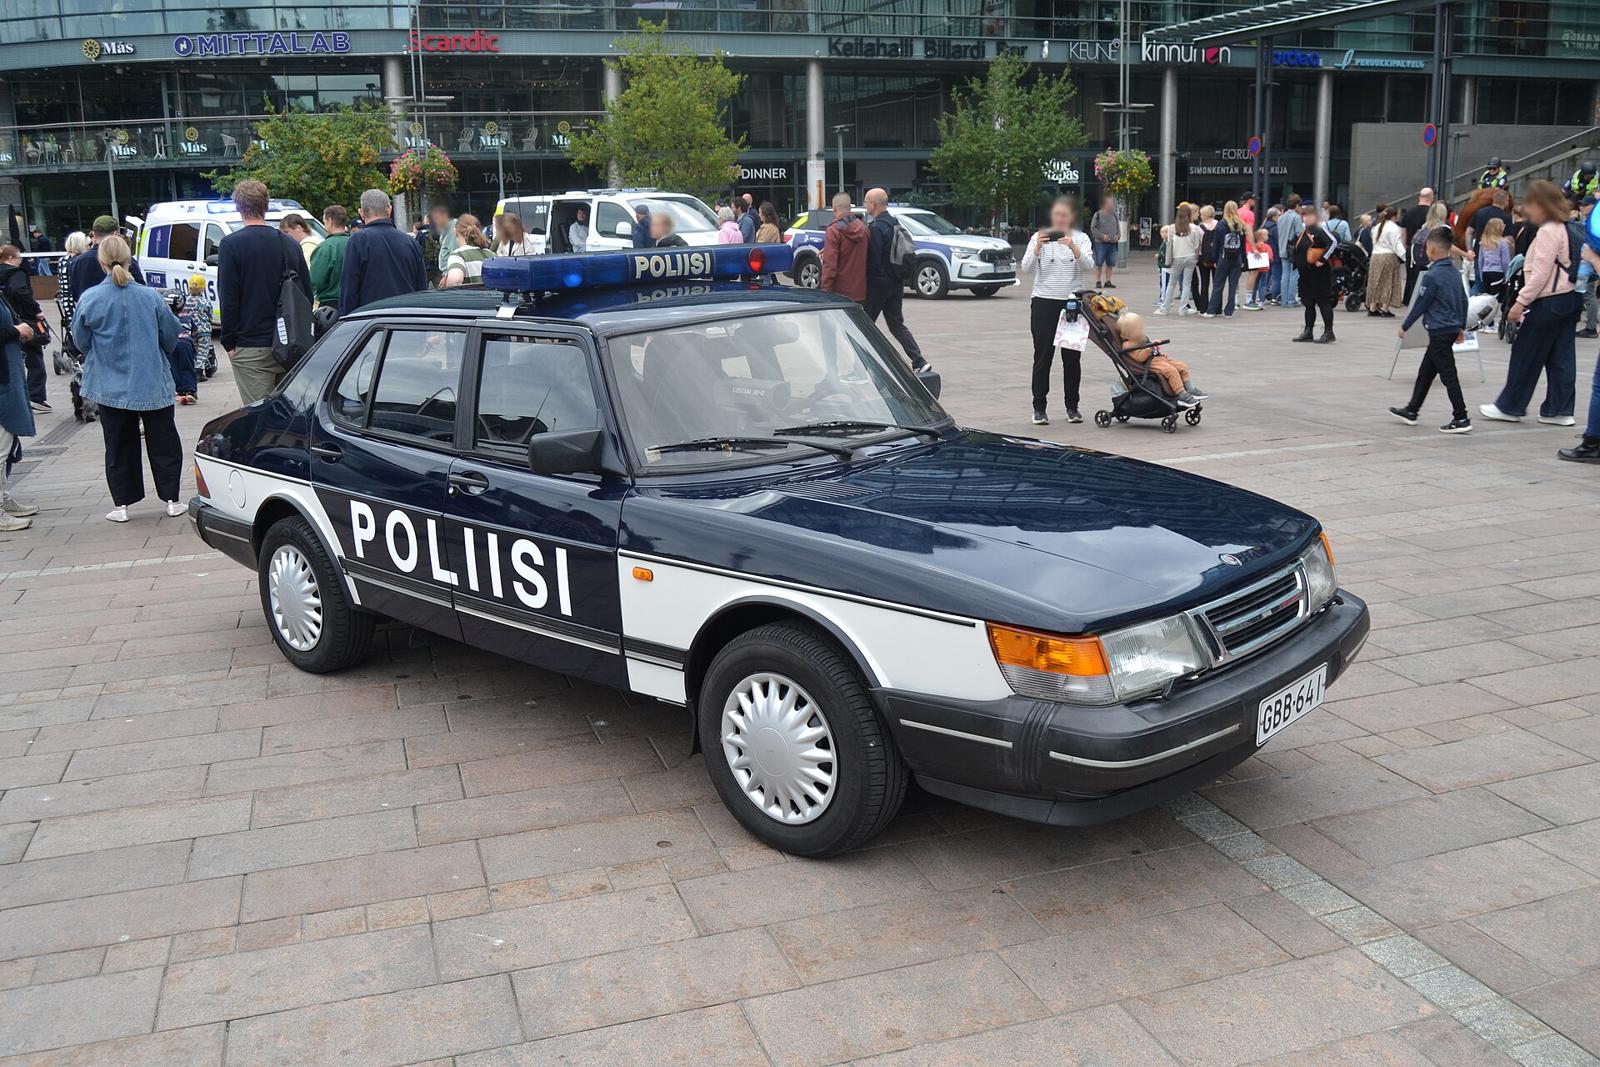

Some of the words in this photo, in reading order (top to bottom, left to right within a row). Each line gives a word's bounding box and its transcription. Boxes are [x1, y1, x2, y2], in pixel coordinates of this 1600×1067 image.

[102, 41, 134, 56] Más
[408, 30, 501, 52] Scandic
[827, 37, 913, 57] Keilahalli
[1069, 42, 1117, 61] KEUNE
[1264, 47, 1320, 66] ordea
[180, 142, 208, 154] Más
[480, 133, 507, 147] Más
[1222, 148, 1257, 160] FORU
[482, 172, 523, 184] TAPAS
[741, 168, 787, 180] DINNER
[1189, 165, 1240, 175] SIMONKENTÄN
[634, 252, 711, 279] POLIISI
[350, 499, 573, 617] POLIISI
[1263, 673, 1321, 734] GBB-641
